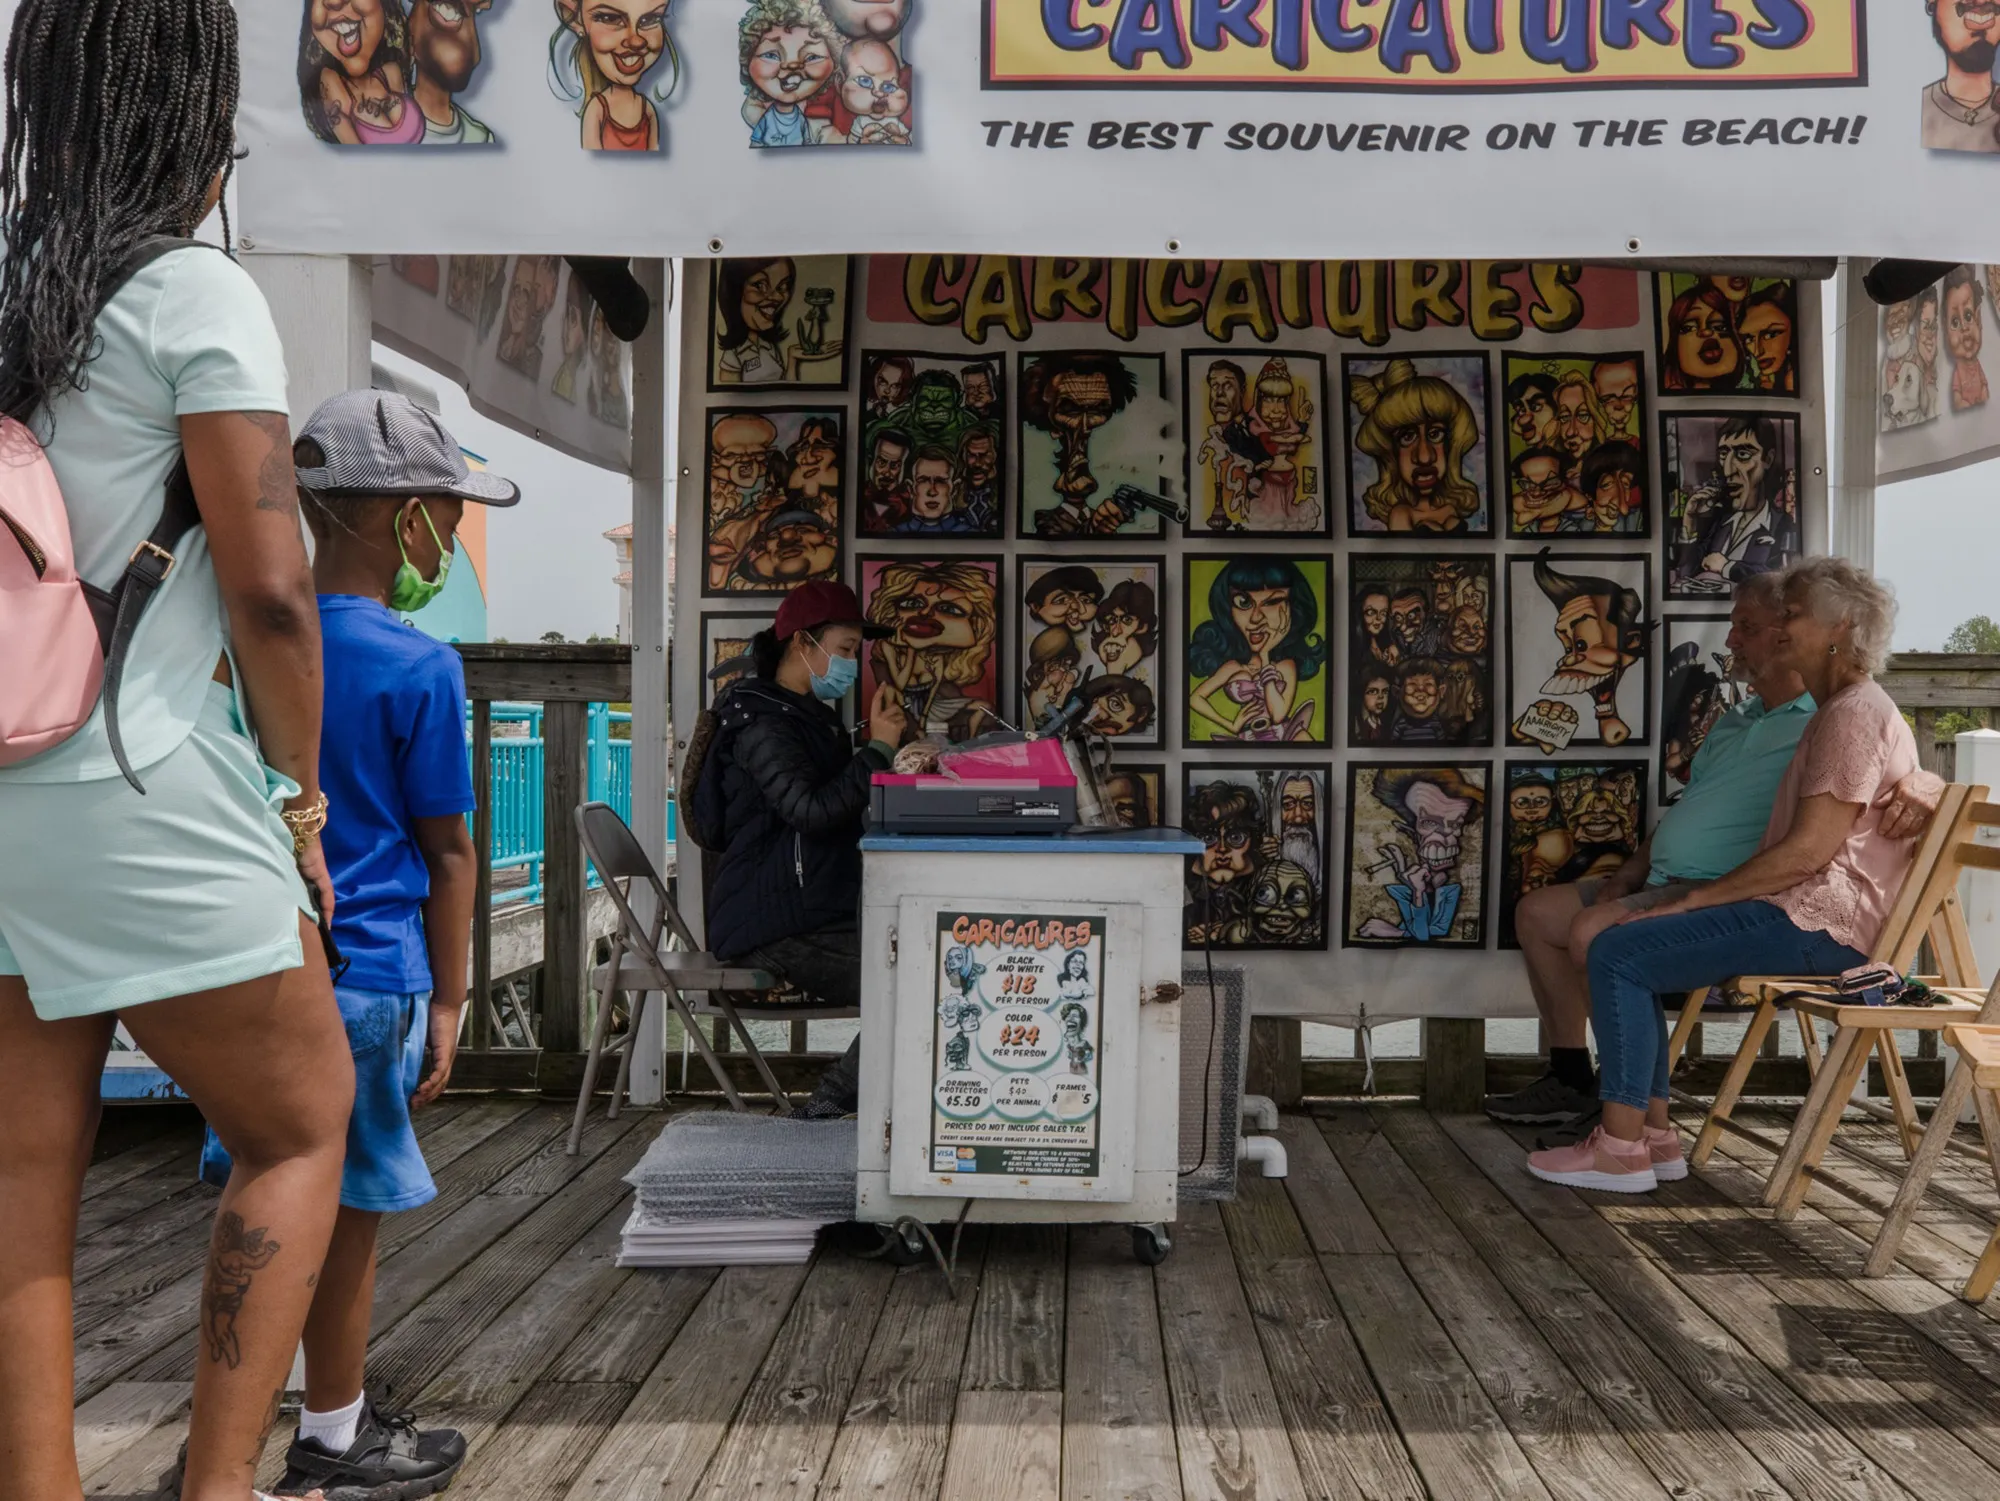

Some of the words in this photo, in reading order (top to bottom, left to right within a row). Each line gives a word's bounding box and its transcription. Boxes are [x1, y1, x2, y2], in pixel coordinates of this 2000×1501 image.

[980, 119, 1074, 149] THE
[1087, 120, 1213, 151] BEST
[1224, 122, 1470, 152] SOUVENIR
[1485, 122, 1556, 150] ON
[1572, 118, 1669, 148] THE
[1681, 114, 1868, 146] BEACH!
[903, 253, 1585, 347] CARICATURES
[1524, 715, 1571, 738] AAALRIGHTY
[951, 915, 1091, 950] CARICATURES
[1006, 955, 1035, 964] BLACK
[996, 964, 1014, 972] AND
[1017, 964, 1045, 973] WHITE
[1001, 973, 1037, 995] $18
[995, 996, 1012, 1004] PER
[1015, 996, 1050, 1005] PERSON
[1005, 1013, 1033, 1022] COLOR
[1000, 1024, 1040, 1047] $24
[993, 1049, 1009, 1057] PER
[1012, 1049, 1047, 1057] PERSON
[939, 1086, 988, 1094] PROTECTORS
[946, 1095, 980, 1108] $5.50
[996, 1098, 1011, 1106] PER
[1013, 1098, 1041, 1106] ANIMAL
[944, 1122, 973, 1130] PRICES
[988, 1123, 1005, 1131] NOT
[1007, 1124, 1041, 1132] INCLUDE
[1070, 1125, 1086, 1133] TAX
